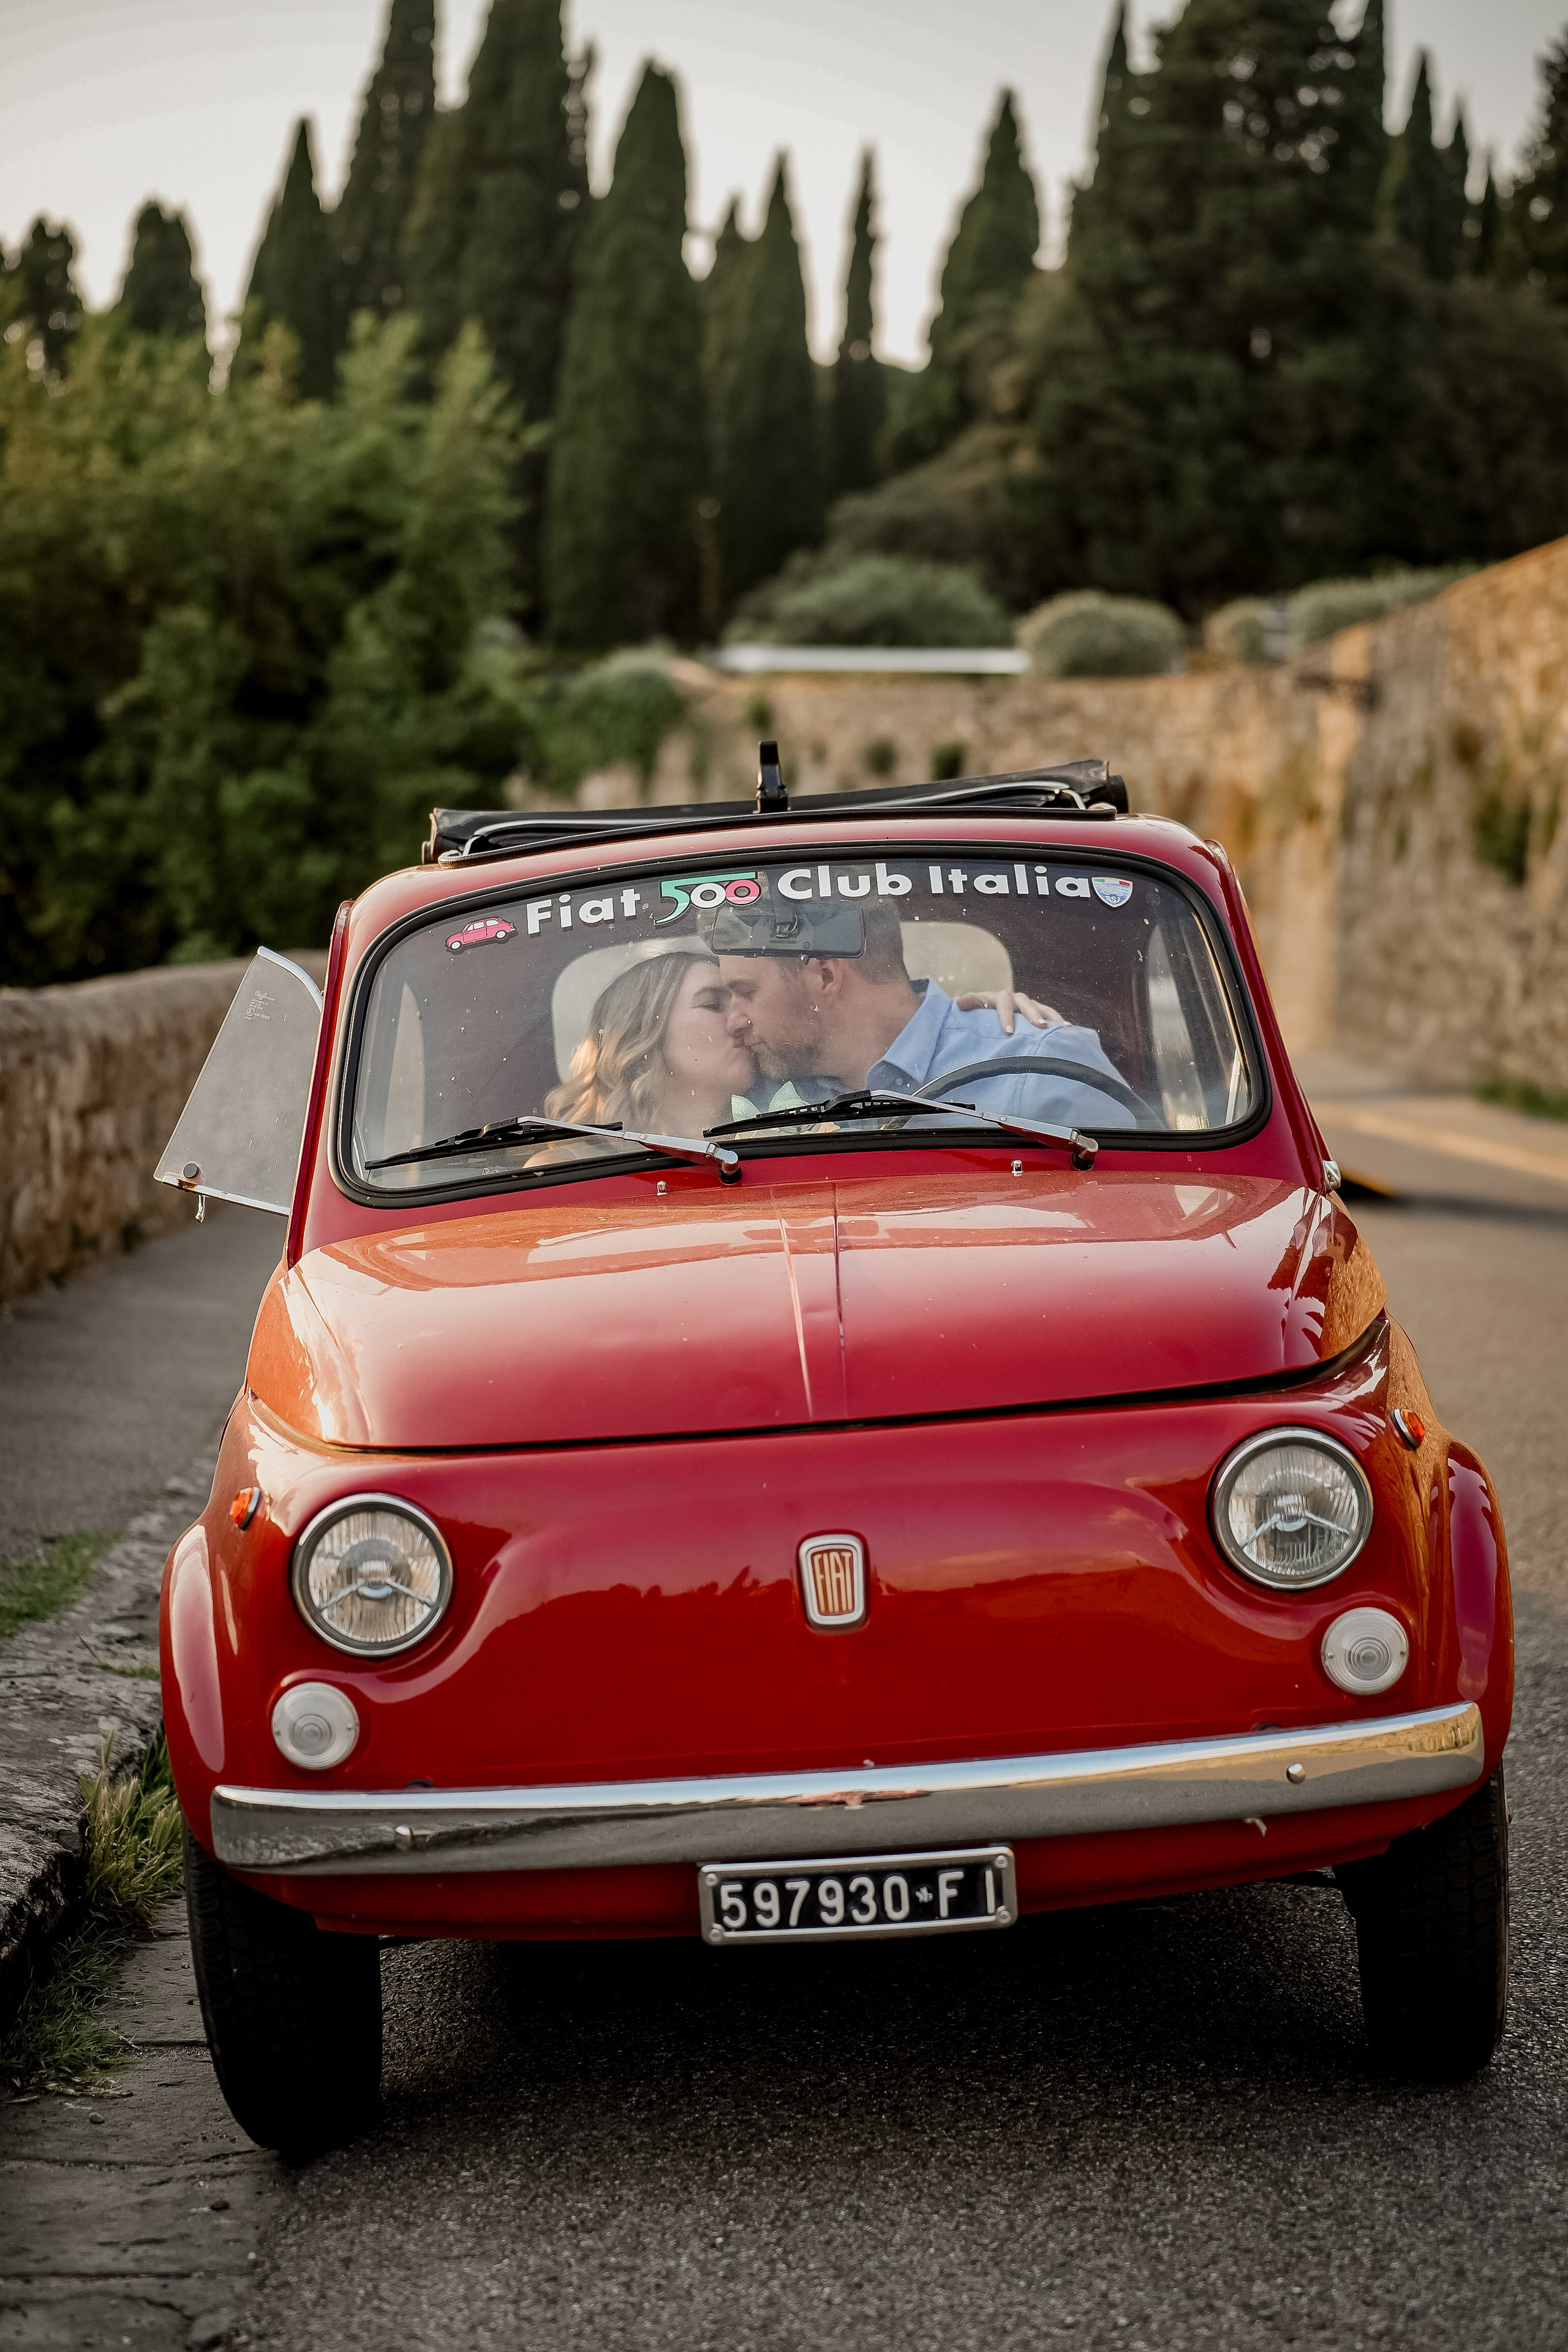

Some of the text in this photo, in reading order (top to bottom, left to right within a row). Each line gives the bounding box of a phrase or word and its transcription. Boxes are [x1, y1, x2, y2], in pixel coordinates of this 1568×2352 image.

[527, 862, 1092, 935] Fiat 500 Club Italia
[813, 1551, 853, 1613] FIAT
[720, 1875, 910, 1928] 597930
